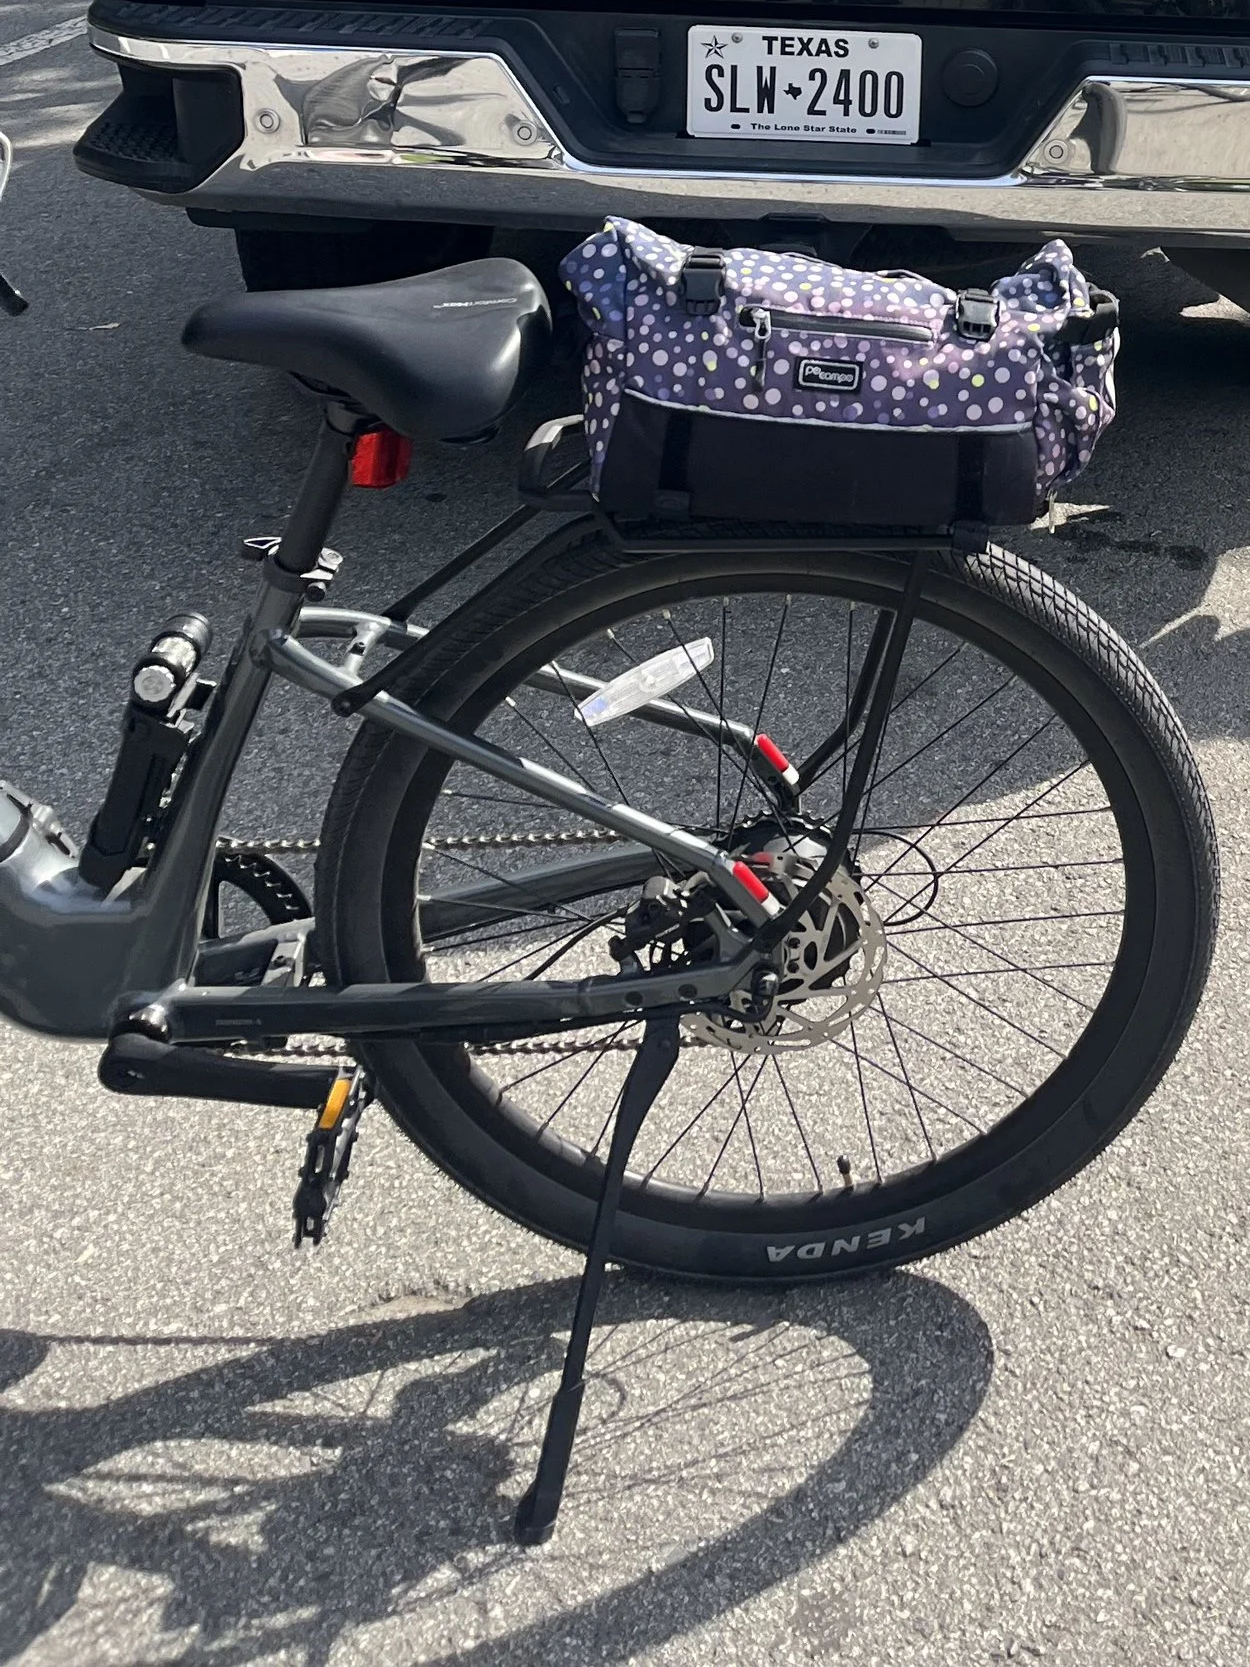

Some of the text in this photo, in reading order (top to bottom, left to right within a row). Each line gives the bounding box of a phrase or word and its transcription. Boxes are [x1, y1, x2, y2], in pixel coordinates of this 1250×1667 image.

[762, 35, 850, 58] TEXAS
[704, 63, 905, 119] SLW 2400
[751, 122, 857, 134] The Lone Star State
[766, 1216, 926, 1263] KENDA
